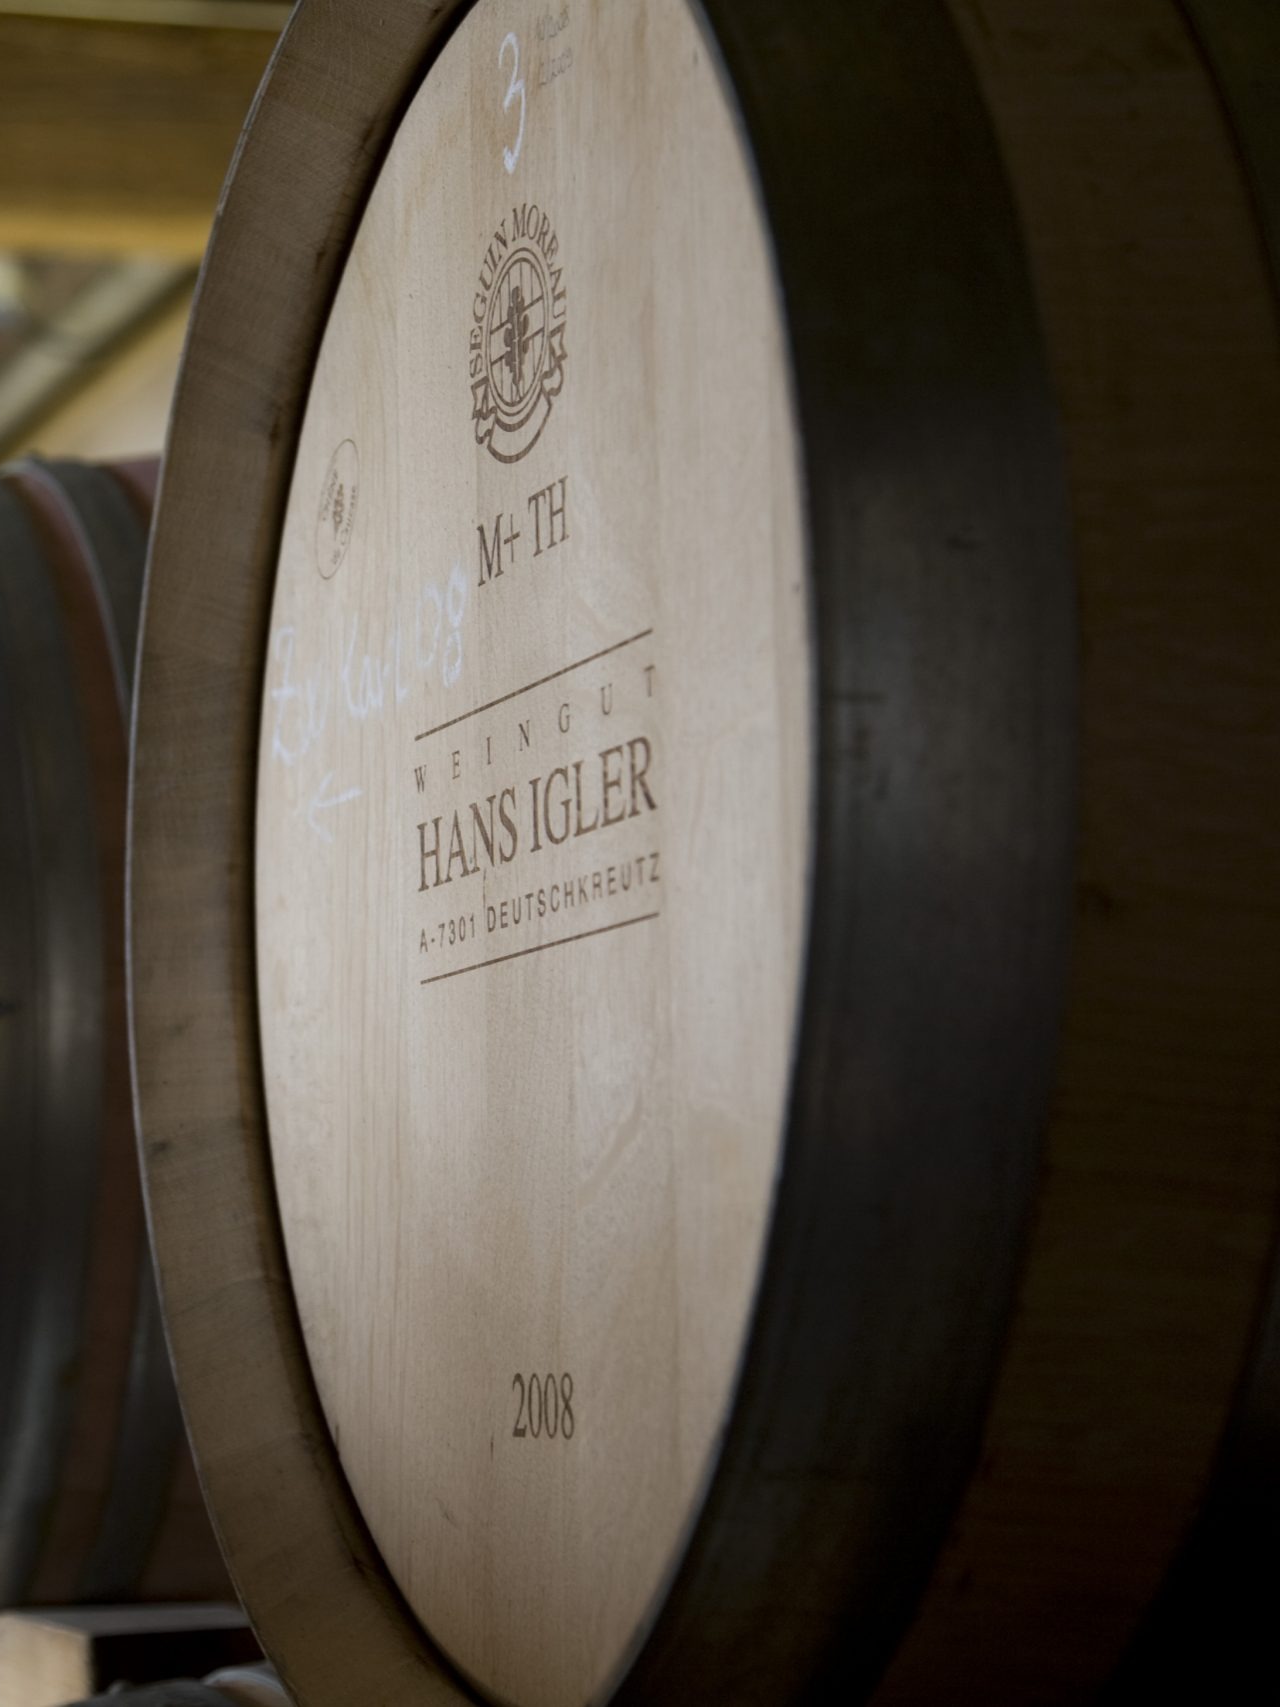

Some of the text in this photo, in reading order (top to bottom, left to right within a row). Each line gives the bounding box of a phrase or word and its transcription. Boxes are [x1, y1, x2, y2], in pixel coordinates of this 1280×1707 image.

[498, 32, 526, 175] 3
[470, 202, 567, 379] SEGUIN MOREAU
[527, 475, 570, 558] TH
[414, 664, 656, 794] WEINGUT
[417, 735, 658, 892] HANS IGLER
[420, 852, 661, 954] A-7301 DEUTSCHKREUTZ
[512, 1372, 575, 1440] 2008
